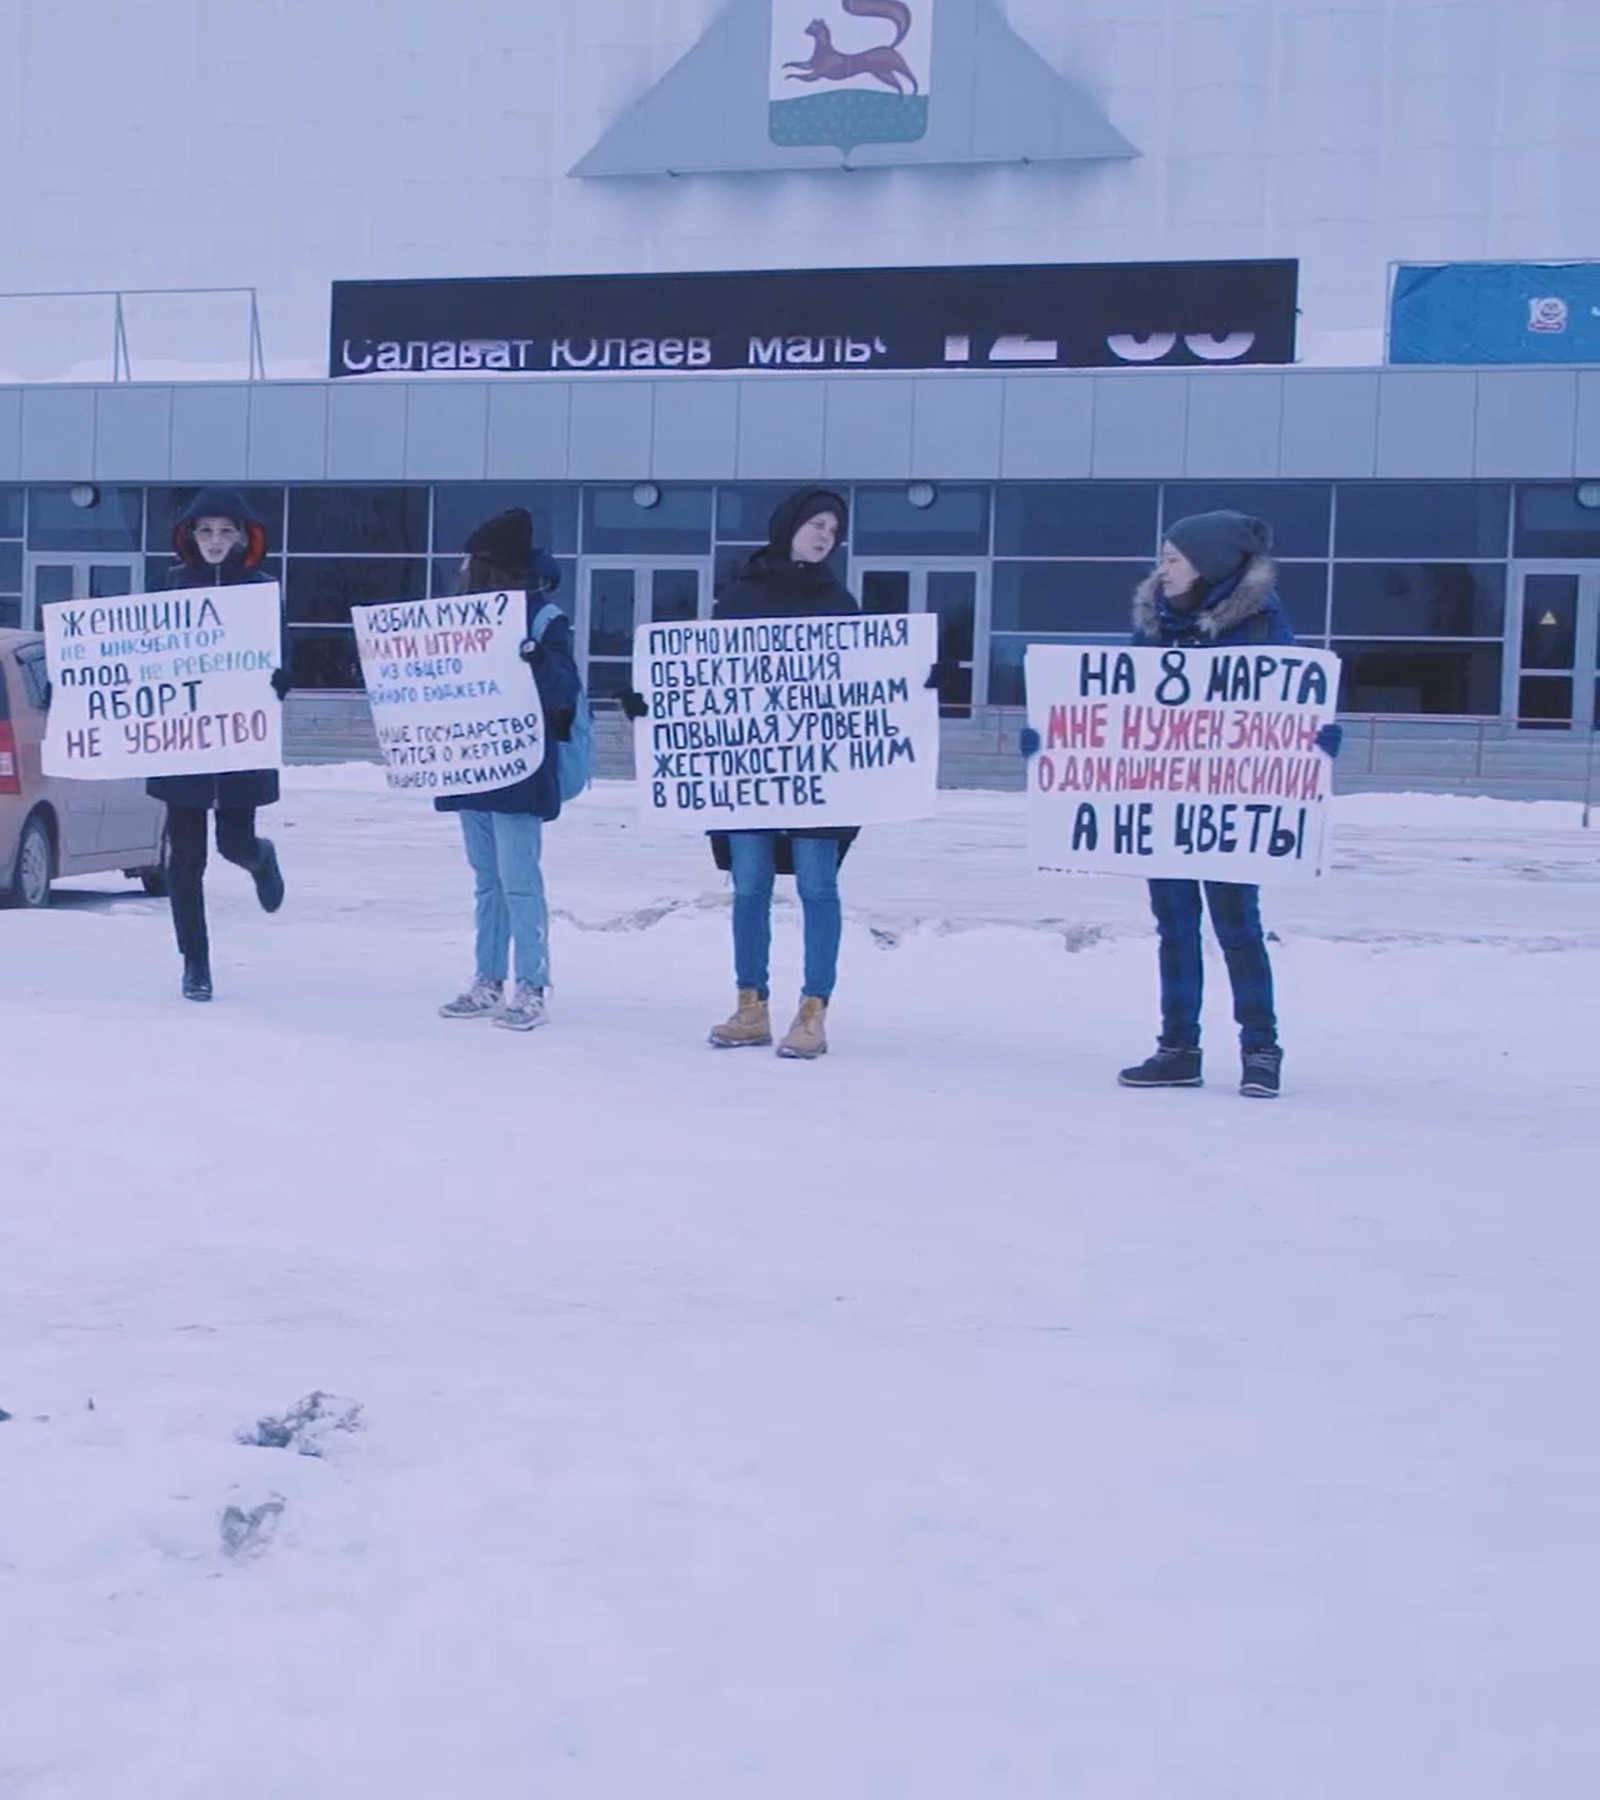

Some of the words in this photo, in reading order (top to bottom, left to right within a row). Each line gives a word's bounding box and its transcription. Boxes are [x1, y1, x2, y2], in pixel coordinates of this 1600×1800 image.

[552, 336, 711, 367] Юлаев
[366, 605, 431, 634] ИЗБИЛ
[437, 592, 509, 628] МУЖ?
[99, 628, 226, 659] ИНКУБАТОР
[424, 627, 493, 657] ШТРАФ
[649, 628, 721, 656] ПОРНО
[724, 626, 739, 653] И
[743, 617, 910, 653] ПОВСЕМЕСТНАЯ
[60, 663, 132, 687] ПЛОД
[381, 662, 399, 680] ИЗ
[405, 657, 463, 681] ОБЩЕГО
[650, 651, 842, 688] ОБЪЕКТИВАЦИЯ
[1079, 651, 1136, 697] НА
[1155, 649, 1192, 706] 8
[1205, 654, 1328, 705] МАРТА
[88, 679, 203, 722] АБОРТ
[369, 683, 418, 706] ЕЙНОГО
[423, 679, 502, 702] БЮДЖЕТА
[651, 686, 755, 720] ВРЕДЯТ
[762, 677, 909, 713] ЖЕНЩИНАМ
[66, 727, 103, 760] НЕ
[124, 709, 268, 755] УБИЙСТВО
[417, 712, 538, 743] ГОСУДАРСТВО
[653, 714, 780, 750] ПОВЫШАЯ
[782, 707, 900, 743] УРОВЕНЬ
[1045, 702, 1109, 750] МНЕ
[1121, 704, 1225, 751] НУЖЕН
[1227, 709, 1320, 754] ЗАКОН
[442, 745, 454, 763] О
[459, 733, 538, 761] ЖЕРТВАХ
[652, 744, 814, 778] ЖЕСТОКОСТИ
[821, 744, 840, 774] К
[848, 736, 916, 770] НИМ
[442, 757, 528, 787] НАСИЛИЯ
[1038, 755, 1055, 793] О
[1058, 754, 1203, 796] ДОМАШНЕМ
[1206, 754, 1324, 803] НАСИЛИИ,
[652, 781, 667, 809] В
[677, 774, 827, 812] ОБЩЕСТВЕ
[1071, 801, 1099, 851] А
[1113, 802, 1155, 856] НЕ
[1174, 802, 1307, 860] ЦВЕТЫ
